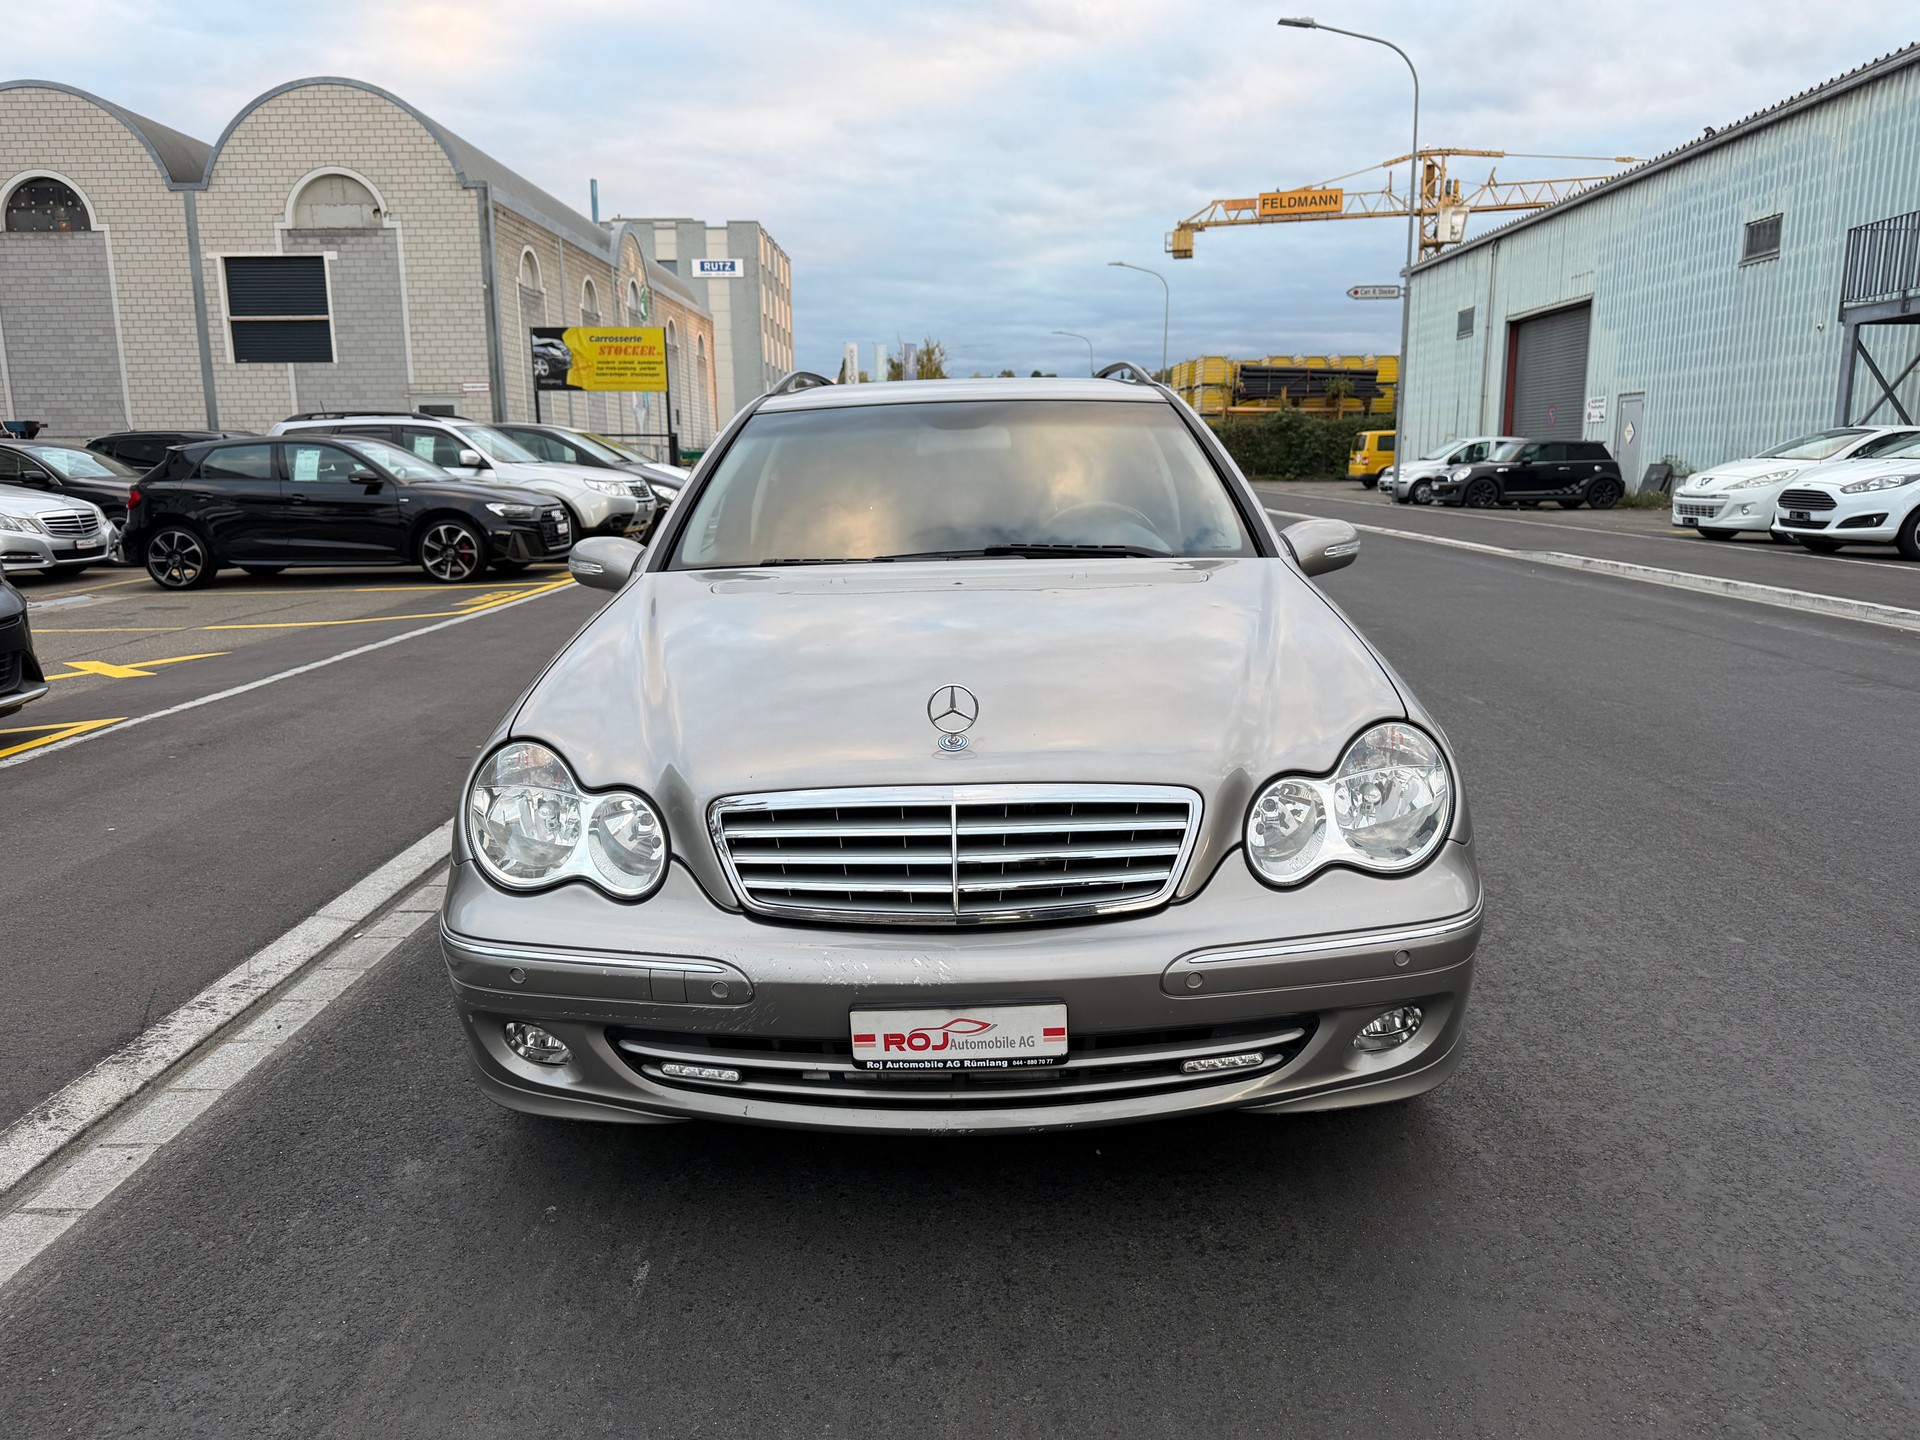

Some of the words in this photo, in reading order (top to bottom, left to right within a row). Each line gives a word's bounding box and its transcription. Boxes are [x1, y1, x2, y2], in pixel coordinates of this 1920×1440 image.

[1262, 194, 1338, 209] FELDMANN
[704, 262, 731, 271] RUTZ
[589, 335, 643, 343] Carrosserie
[598, 344, 657, 356] STOCKER
[883, 1032, 949, 1051] ROJ
[949, 1036, 1016, 1050] Automobile
[1019, 1035, 1035, 1048] AG
[866, 1061, 883, 1069] Roj
[886, 1060, 944, 1069] Automobile
[946, 1060, 961, 1068] AG
[964, 1059, 1008, 1068] Rümlang
